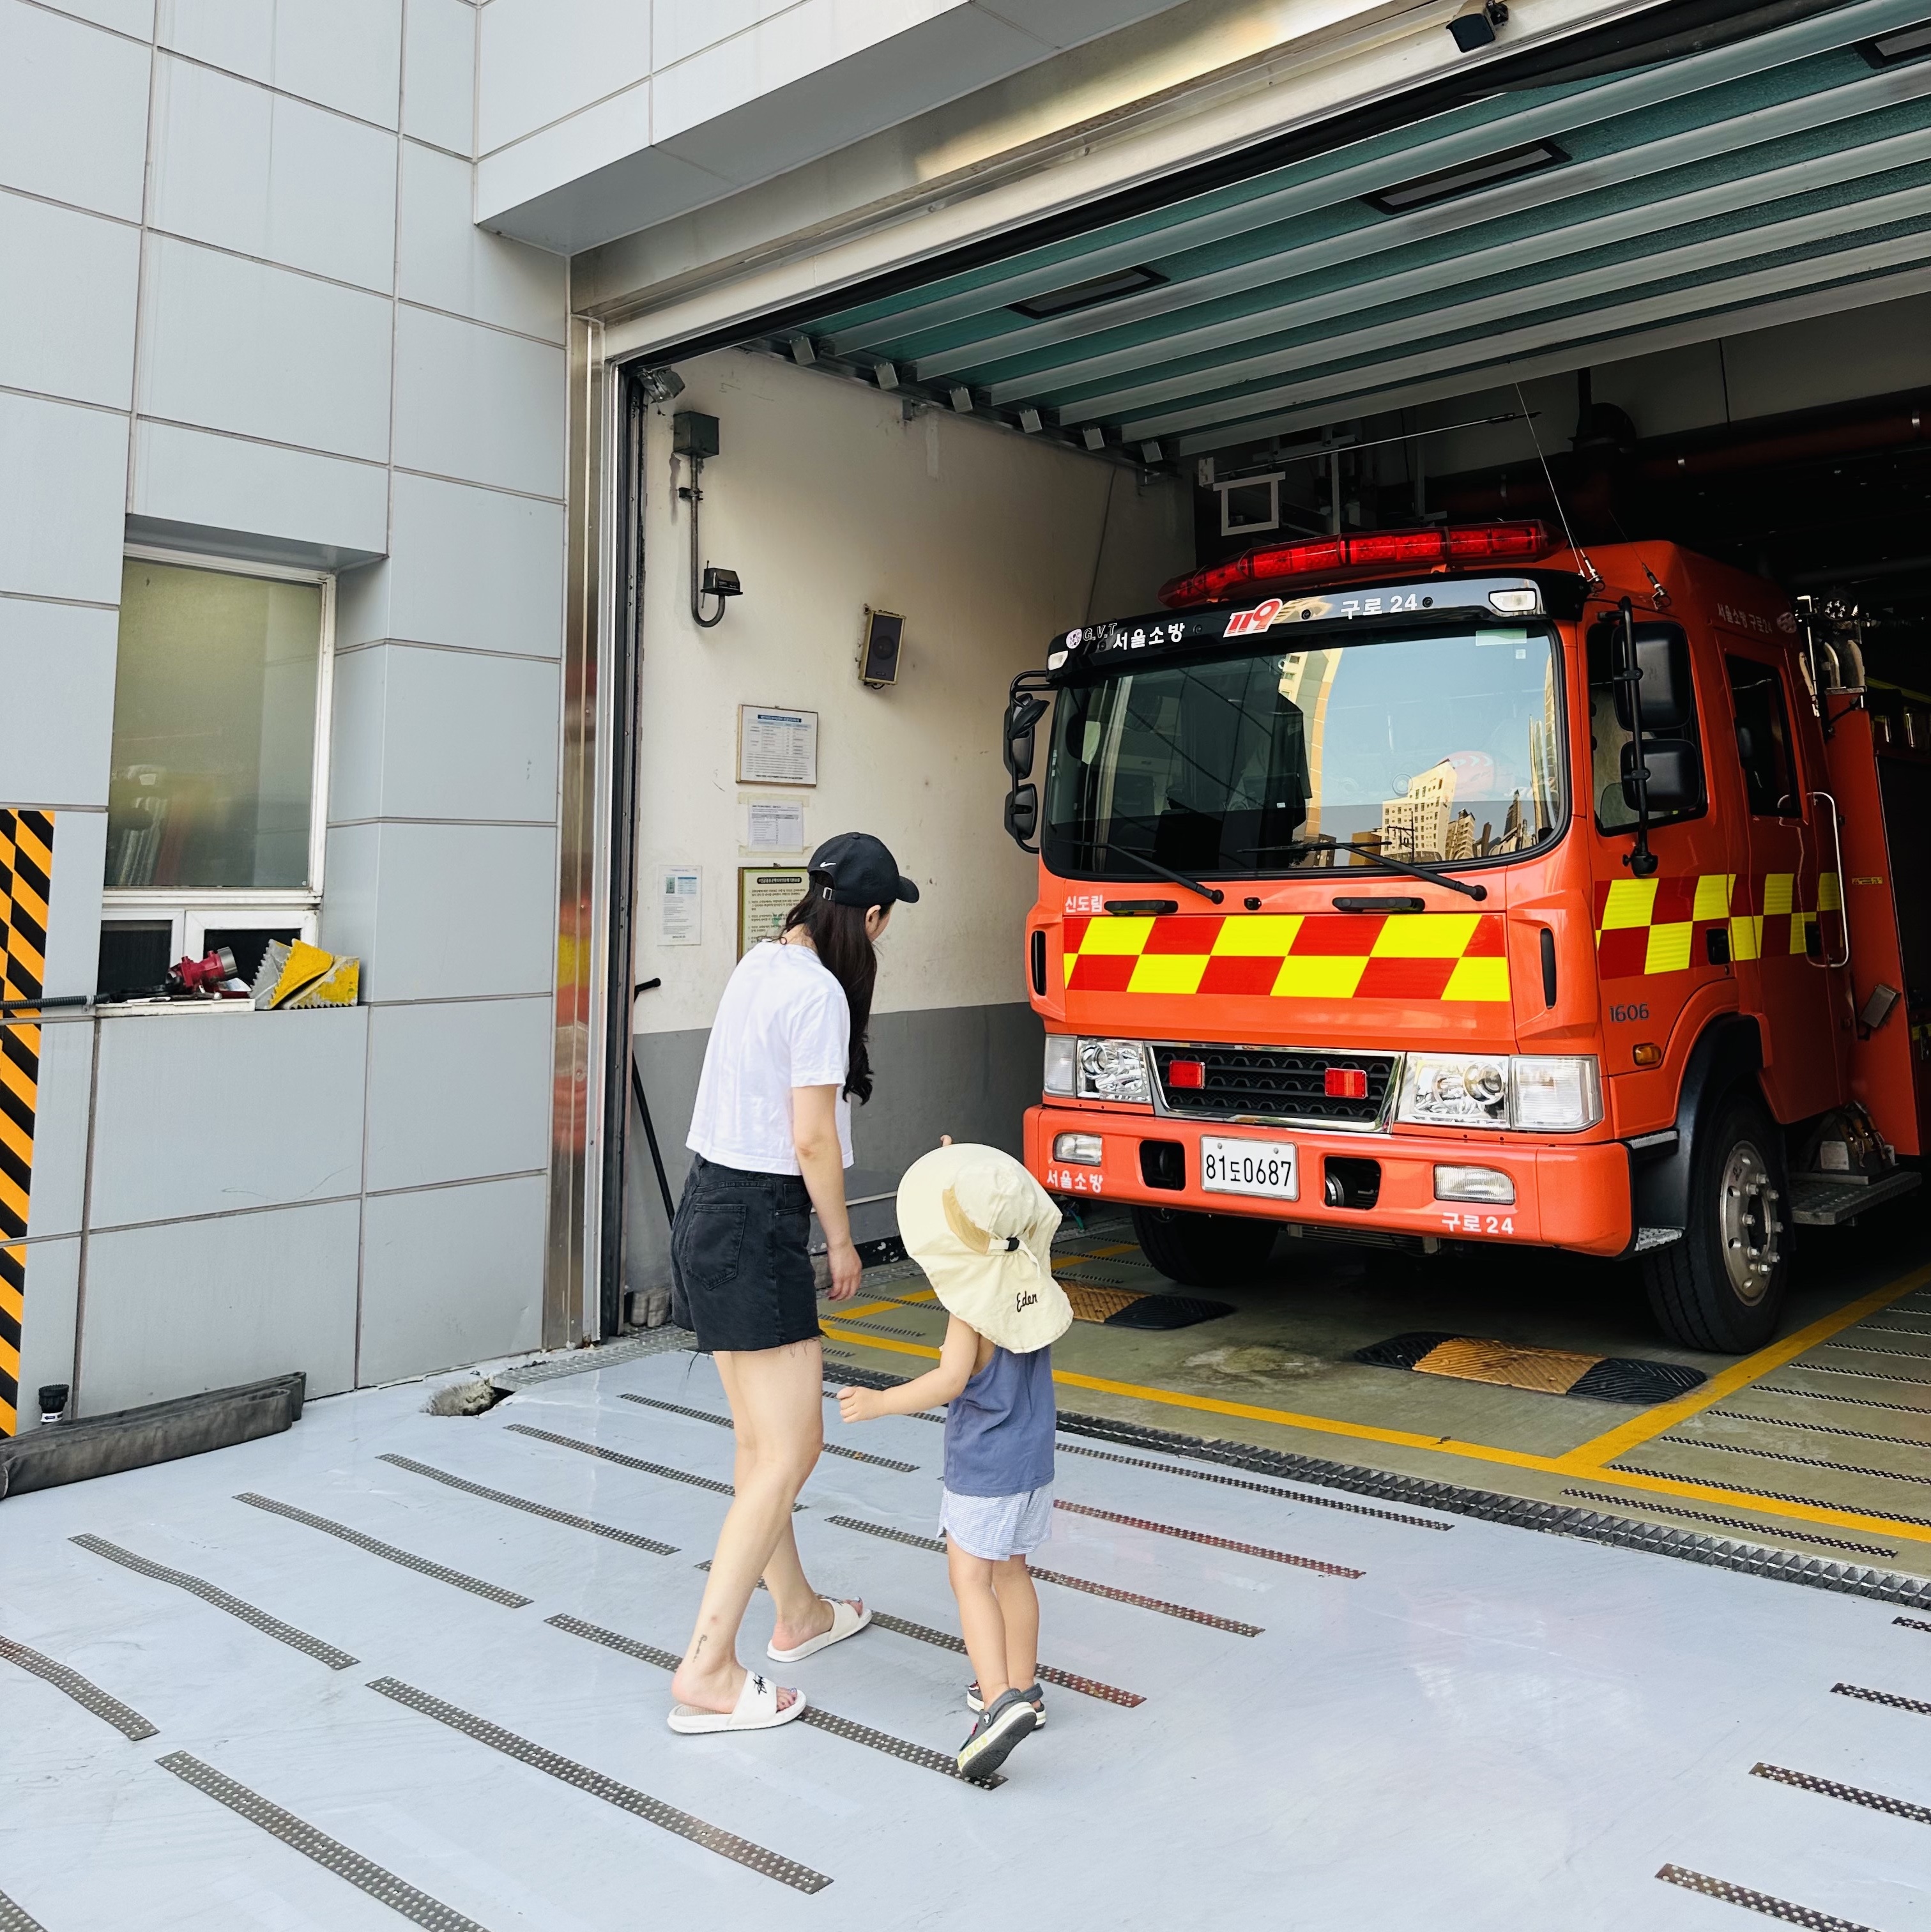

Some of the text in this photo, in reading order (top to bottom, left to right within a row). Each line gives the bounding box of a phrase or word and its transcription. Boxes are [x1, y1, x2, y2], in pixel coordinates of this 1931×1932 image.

[1225, 599, 1282, 637] 119
[1339, 593, 1418, 620] 구로 24
[1113, 622, 1186, 650] 서울소방
[1064, 894, 1103, 913] 신도림
[1609, 1002, 1650, 1023] 1606
[1046, 1169, 1104, 1193] 서울소방
[1206, 1154, 1292, 1187] 81도0687
[1441, 1212, 1514, 1235] 구로 24
[1016, 1291, 1038, 1313] Eden
